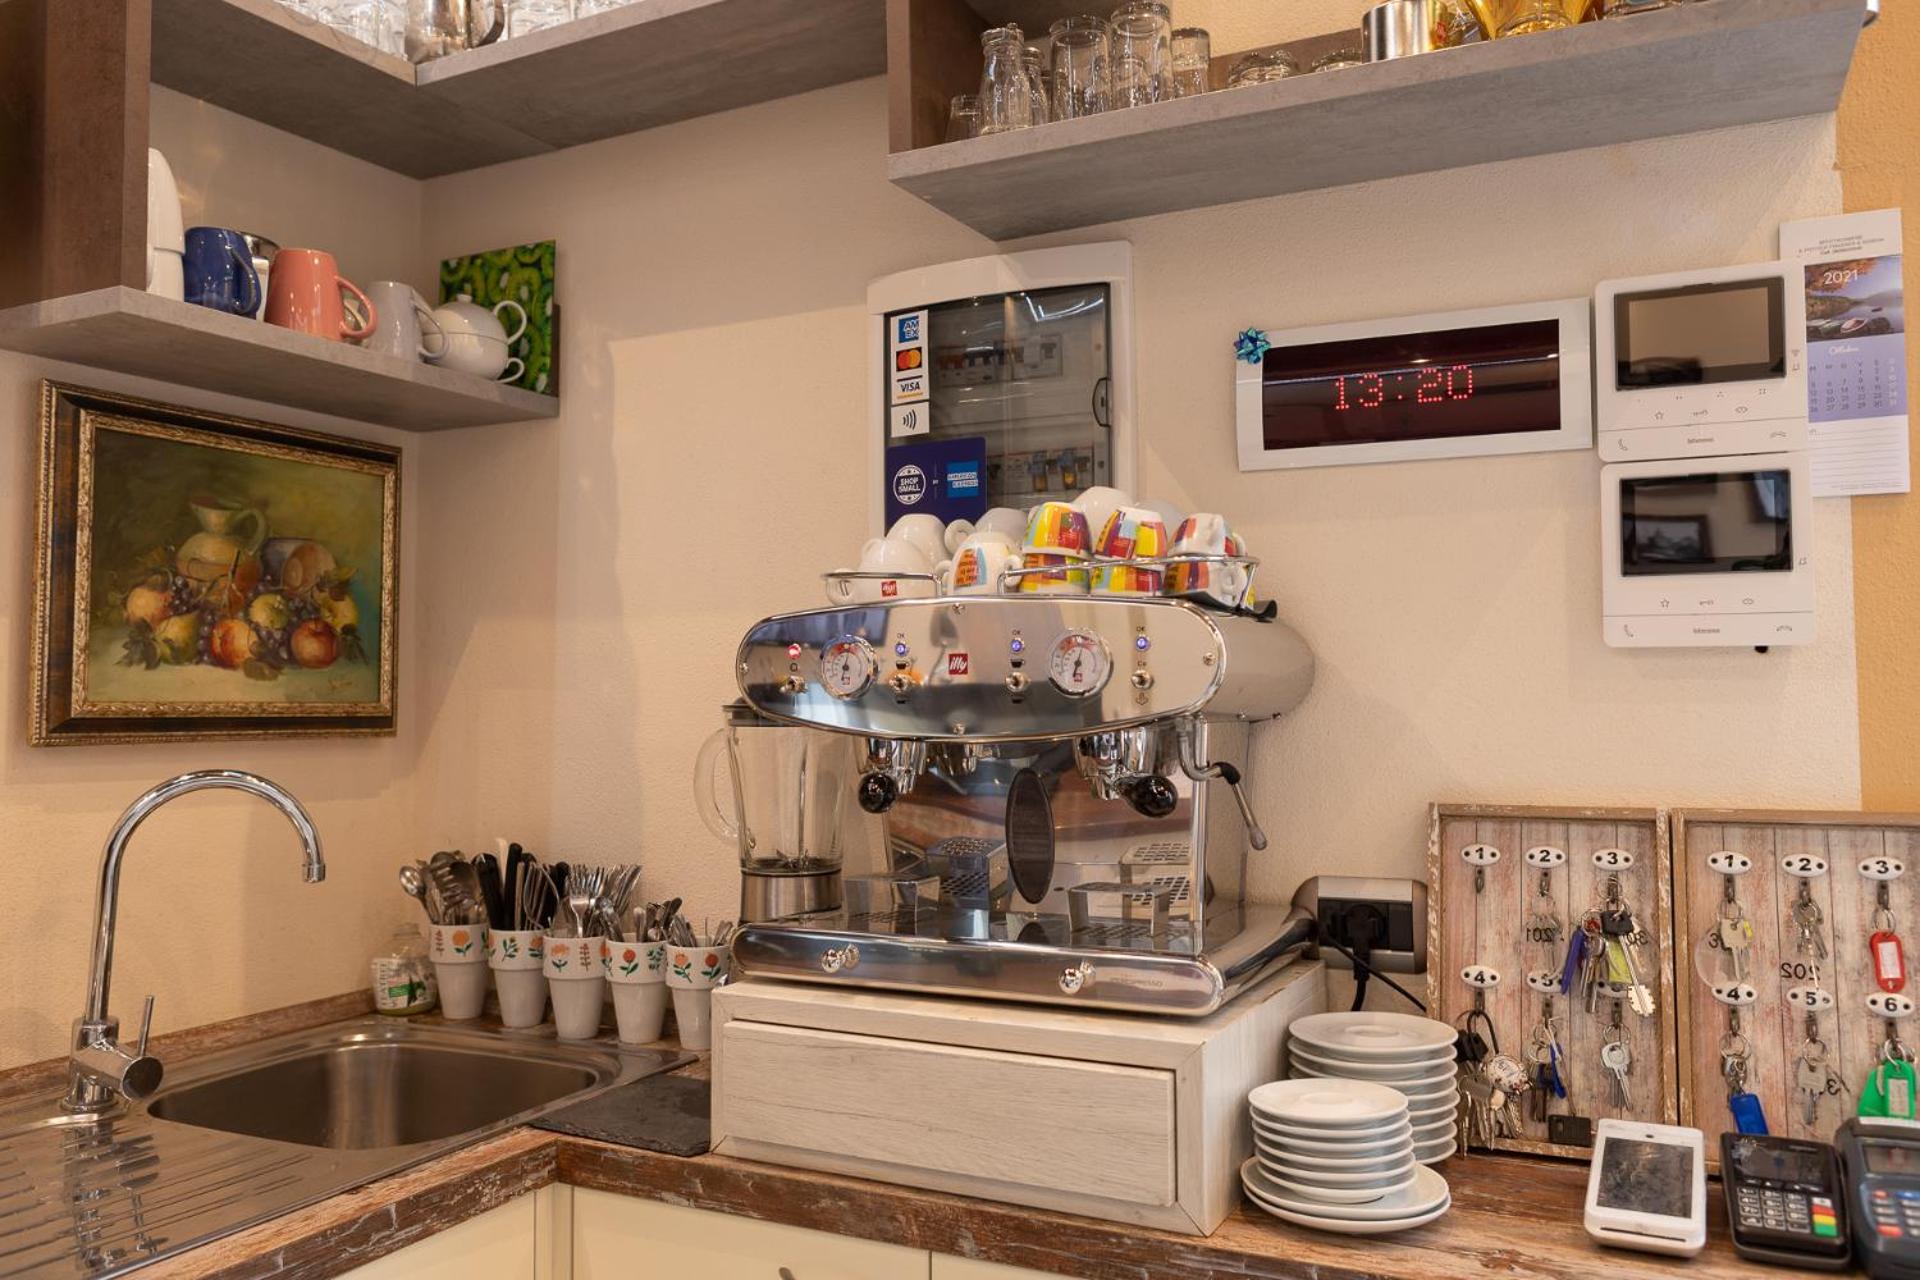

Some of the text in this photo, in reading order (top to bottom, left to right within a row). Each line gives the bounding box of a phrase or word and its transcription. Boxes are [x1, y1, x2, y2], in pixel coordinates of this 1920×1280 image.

[1823, 270, 1858, 285] 2021
[904, 320, 920, 331] AM
[900, 381, 920, 392] VISA
[898, 484, 921, 493] SMALL
[900, 477, 919, 486] SHOP
[949, 654, 968, 674] illy
[1475, 846, 1484, 860] 1
[1539, 849, 1551, 862] 2
[1607, 851, 1619, 865] 3
[1725, 854, 1735, 868] 1
[1799, 858, 1812, 871] 2
[1876, 860, 1889, 874] 3
[1474, 971, 1486, 984] 4
[1726, 987, 1740, 1001] 4
[1805, 992, 1817, 1006] 5
[1885, 997, 1897, 1012] 6
